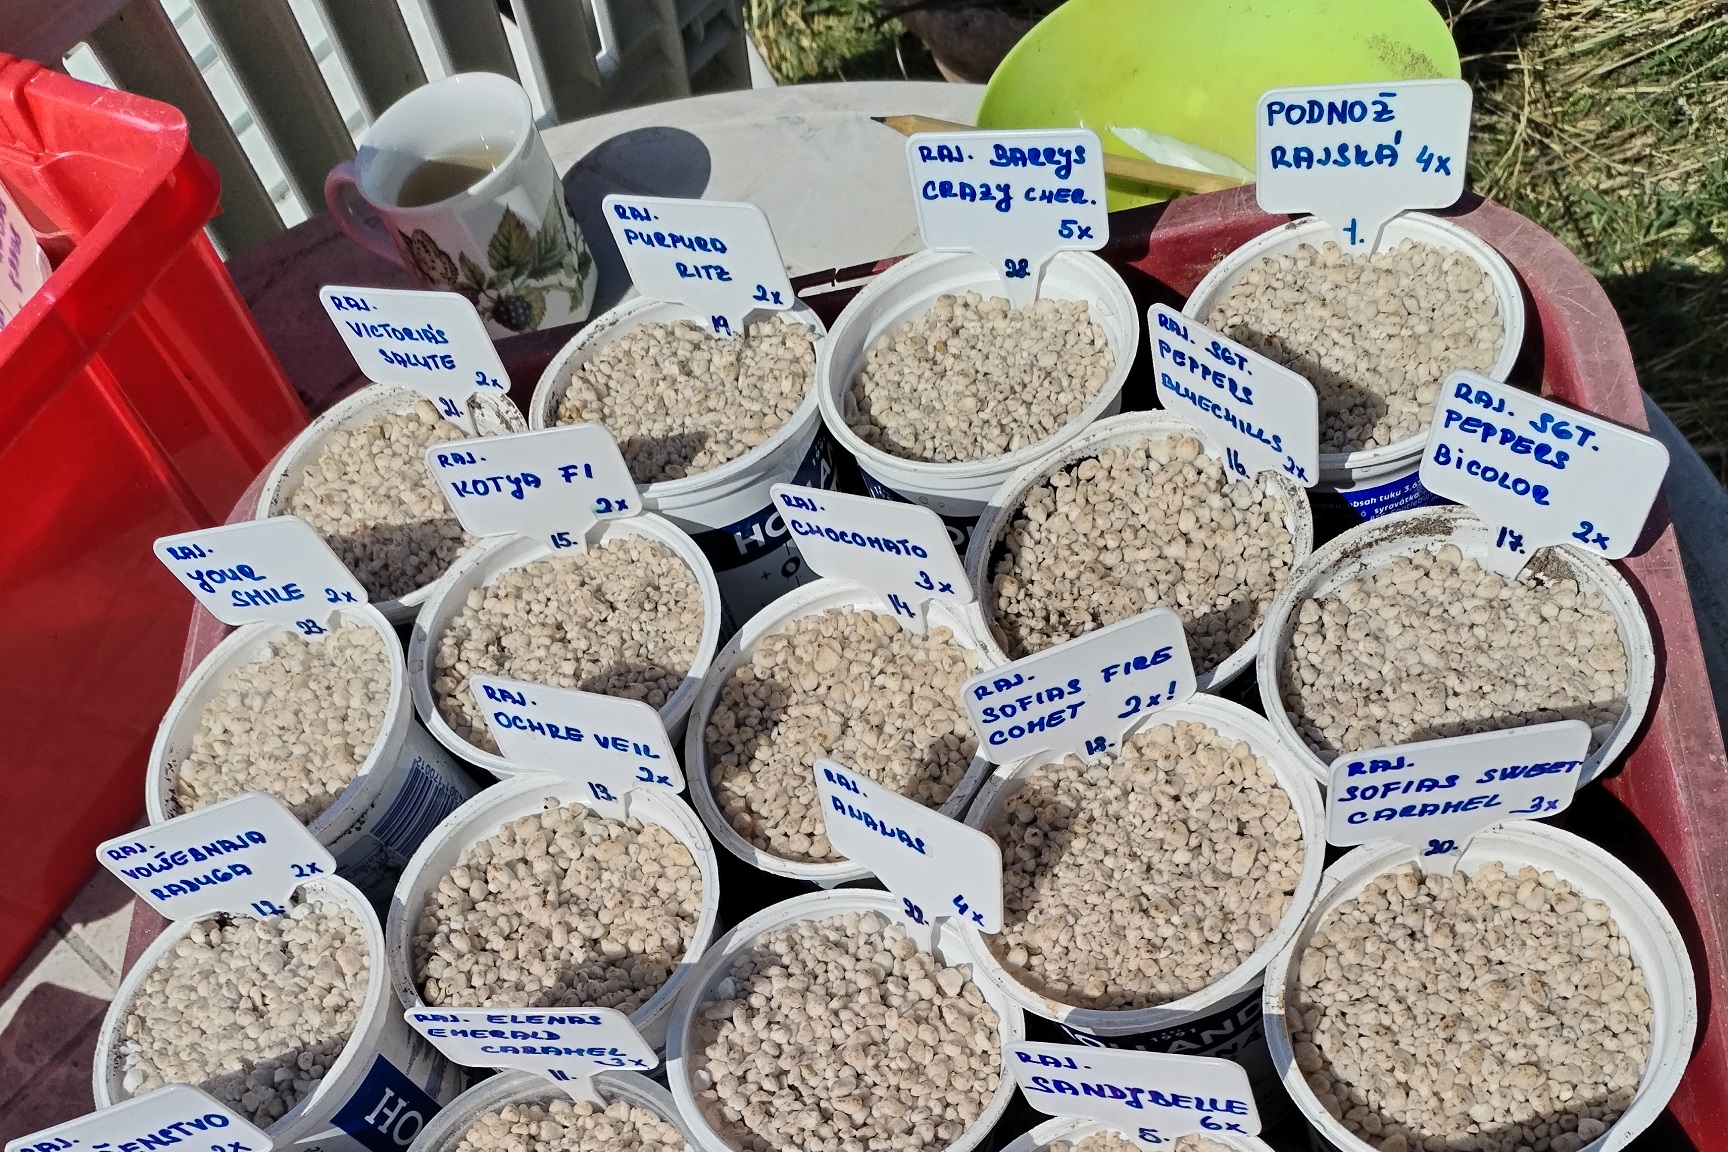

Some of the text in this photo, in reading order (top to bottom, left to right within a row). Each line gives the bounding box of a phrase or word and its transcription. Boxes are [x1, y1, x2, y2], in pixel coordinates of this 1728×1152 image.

[918, 145, 973, 163] RAJ.
[1271, 130, 1451, 176] RAJSKÁ 4x
[1024, 187, 1096, 205] CHER.
[614, 204, 659, 221] RAJ.
[1058, 220, 1093, 240] 5x
[675, 262, 732, 282] RITZ
[330, 296, 377, 311] RAJ.
[753, 284, 783, 305] 2x
[1158, 313, 1252, 379] RAJ. SGT.
[379, 349, 456, 371] SALUTE
[475, 371, 503, 389] 2x
[1158, 339, 1253, 409] PEPPERS
[1450, 380, 1599, 455] RAJ. SGT.
[1440, 405, 1573, 473] PEPPERS
[437, 452, 486, 468] RAJ.
[1282, 456, 1308, 482] 2x
[592, 498, 628, 514] 2x
[780, 494, 825, 512] RAJ.
[551, 532, 576, 549] 15.
[1572, 521, 1610, 550] 2x
[166, 544, 213, 560] RAJ.
[232, 583, 358, 607] SMILE 2x
[482, 685, 537, 706] RAJ.
[974, 674, 1035, 704] RAJ.
[978, 646, 1176, 727] SOFIAS FIRE
[985, 697, 1085, 745] COMET
[494, 712, 660, 759] OCHRE VEIL
[636, 767, 673, 787] 2x
[1347, 756, 1414, 777] RAJ.
[824, 769, 867, 801] RAJ.
[1338, 775, 1464, 806] SOFIAS
[1343, 790, 1502, 824] CARAMEL
[107, 843, 159, 861] RAJ.
[147, 860, 324, 901] RADUGA 2x
[413, 1014, 602, 1025] RAJ. ELENAS
[428, 1029, 560, 1040] EMERALD
[481, 1046, 626, 1056] CARAMEL
[1015, 1051, 1091, 1069] RAJ.
[1200, 1116, 1248, 1134] 6x
